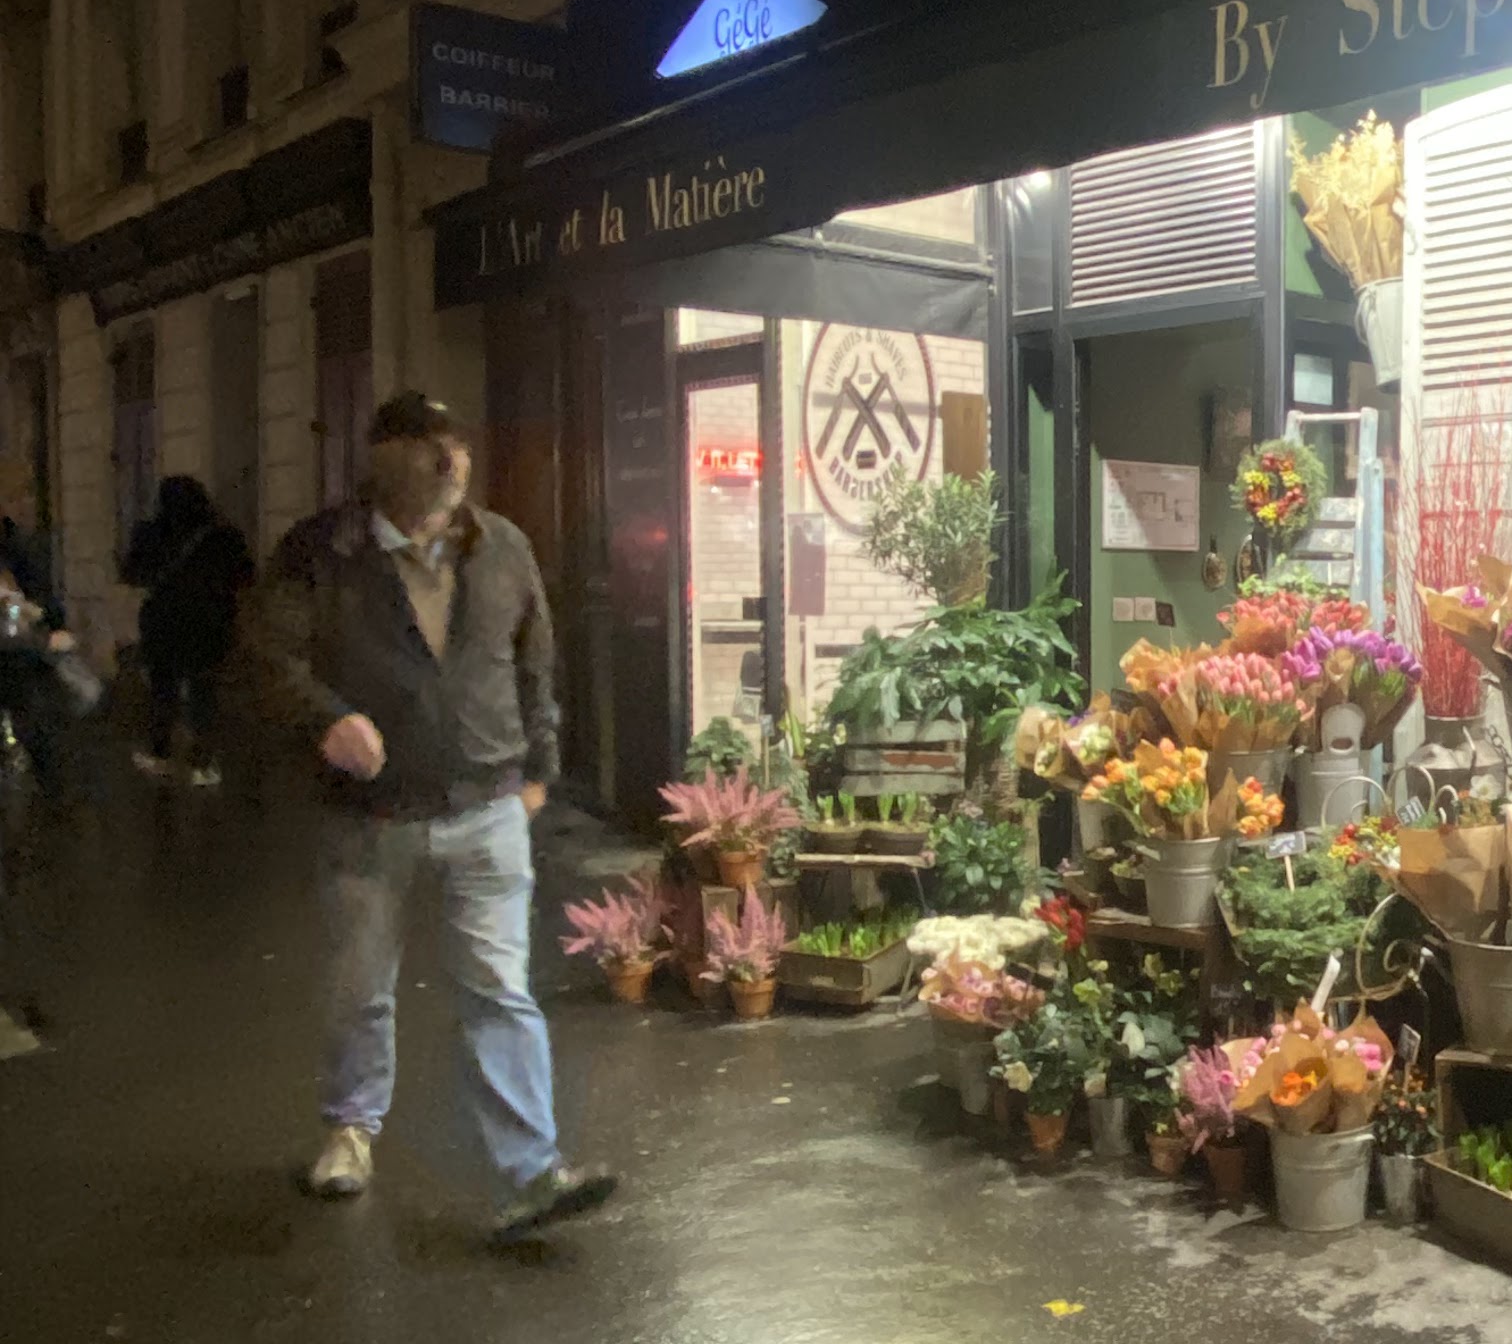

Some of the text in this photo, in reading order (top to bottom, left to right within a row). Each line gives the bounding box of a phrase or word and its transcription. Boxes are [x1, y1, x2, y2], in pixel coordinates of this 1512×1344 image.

[558, 208, 582, 256] et
[599, 190, 626, 246] la
[645, 155, 766, 234] Matière
